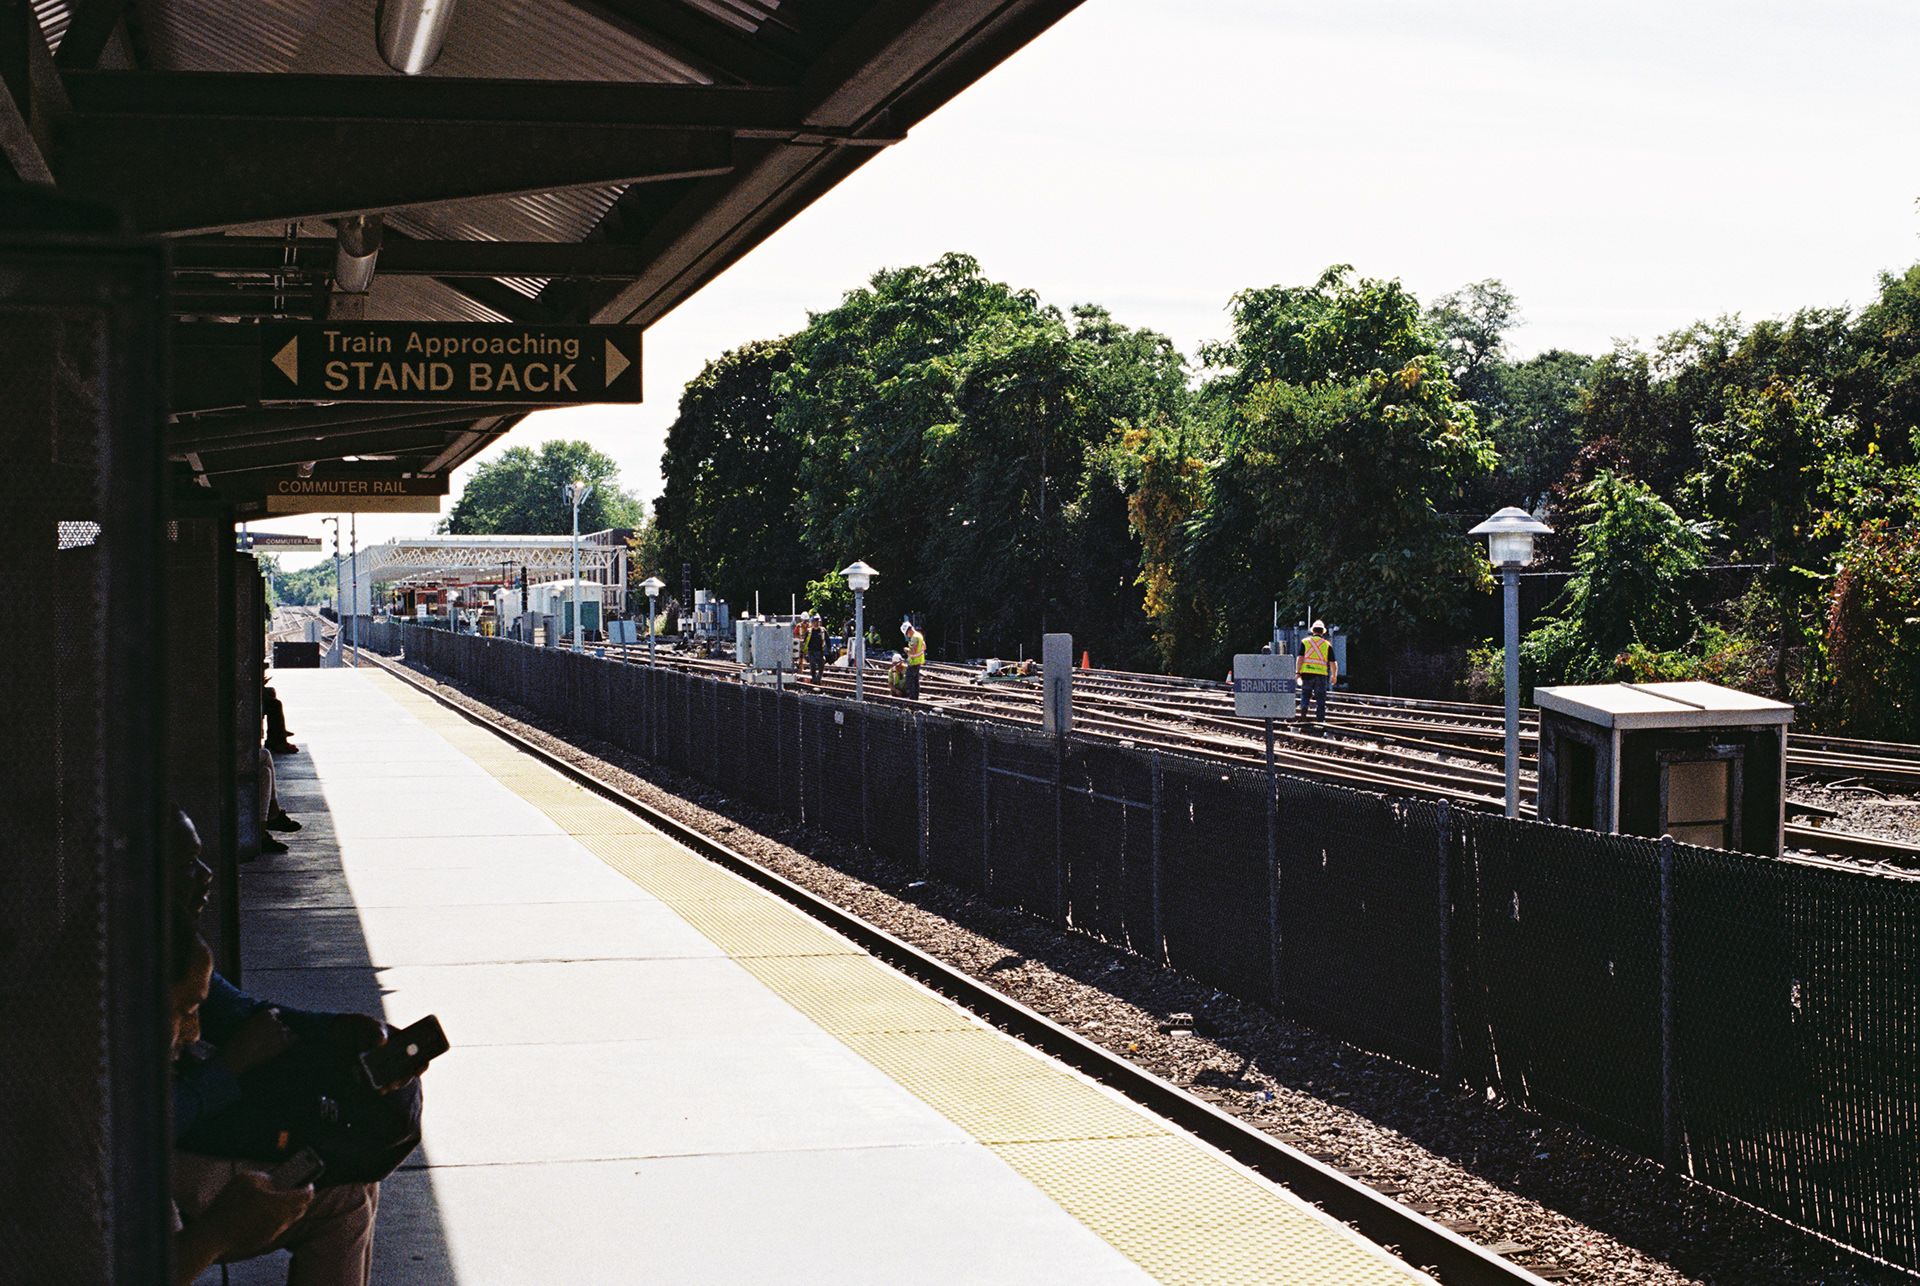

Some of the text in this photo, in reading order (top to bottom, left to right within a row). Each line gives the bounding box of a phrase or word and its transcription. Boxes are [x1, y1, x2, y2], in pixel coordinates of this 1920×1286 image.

[323, 330, 580, 360] Train Approaching
[324, 360, 579, 392] STAND BACK
[278, 480, 407, 494] COMMUTER RAIL
[1241, 680, 1288, 692] BRAINTREE
